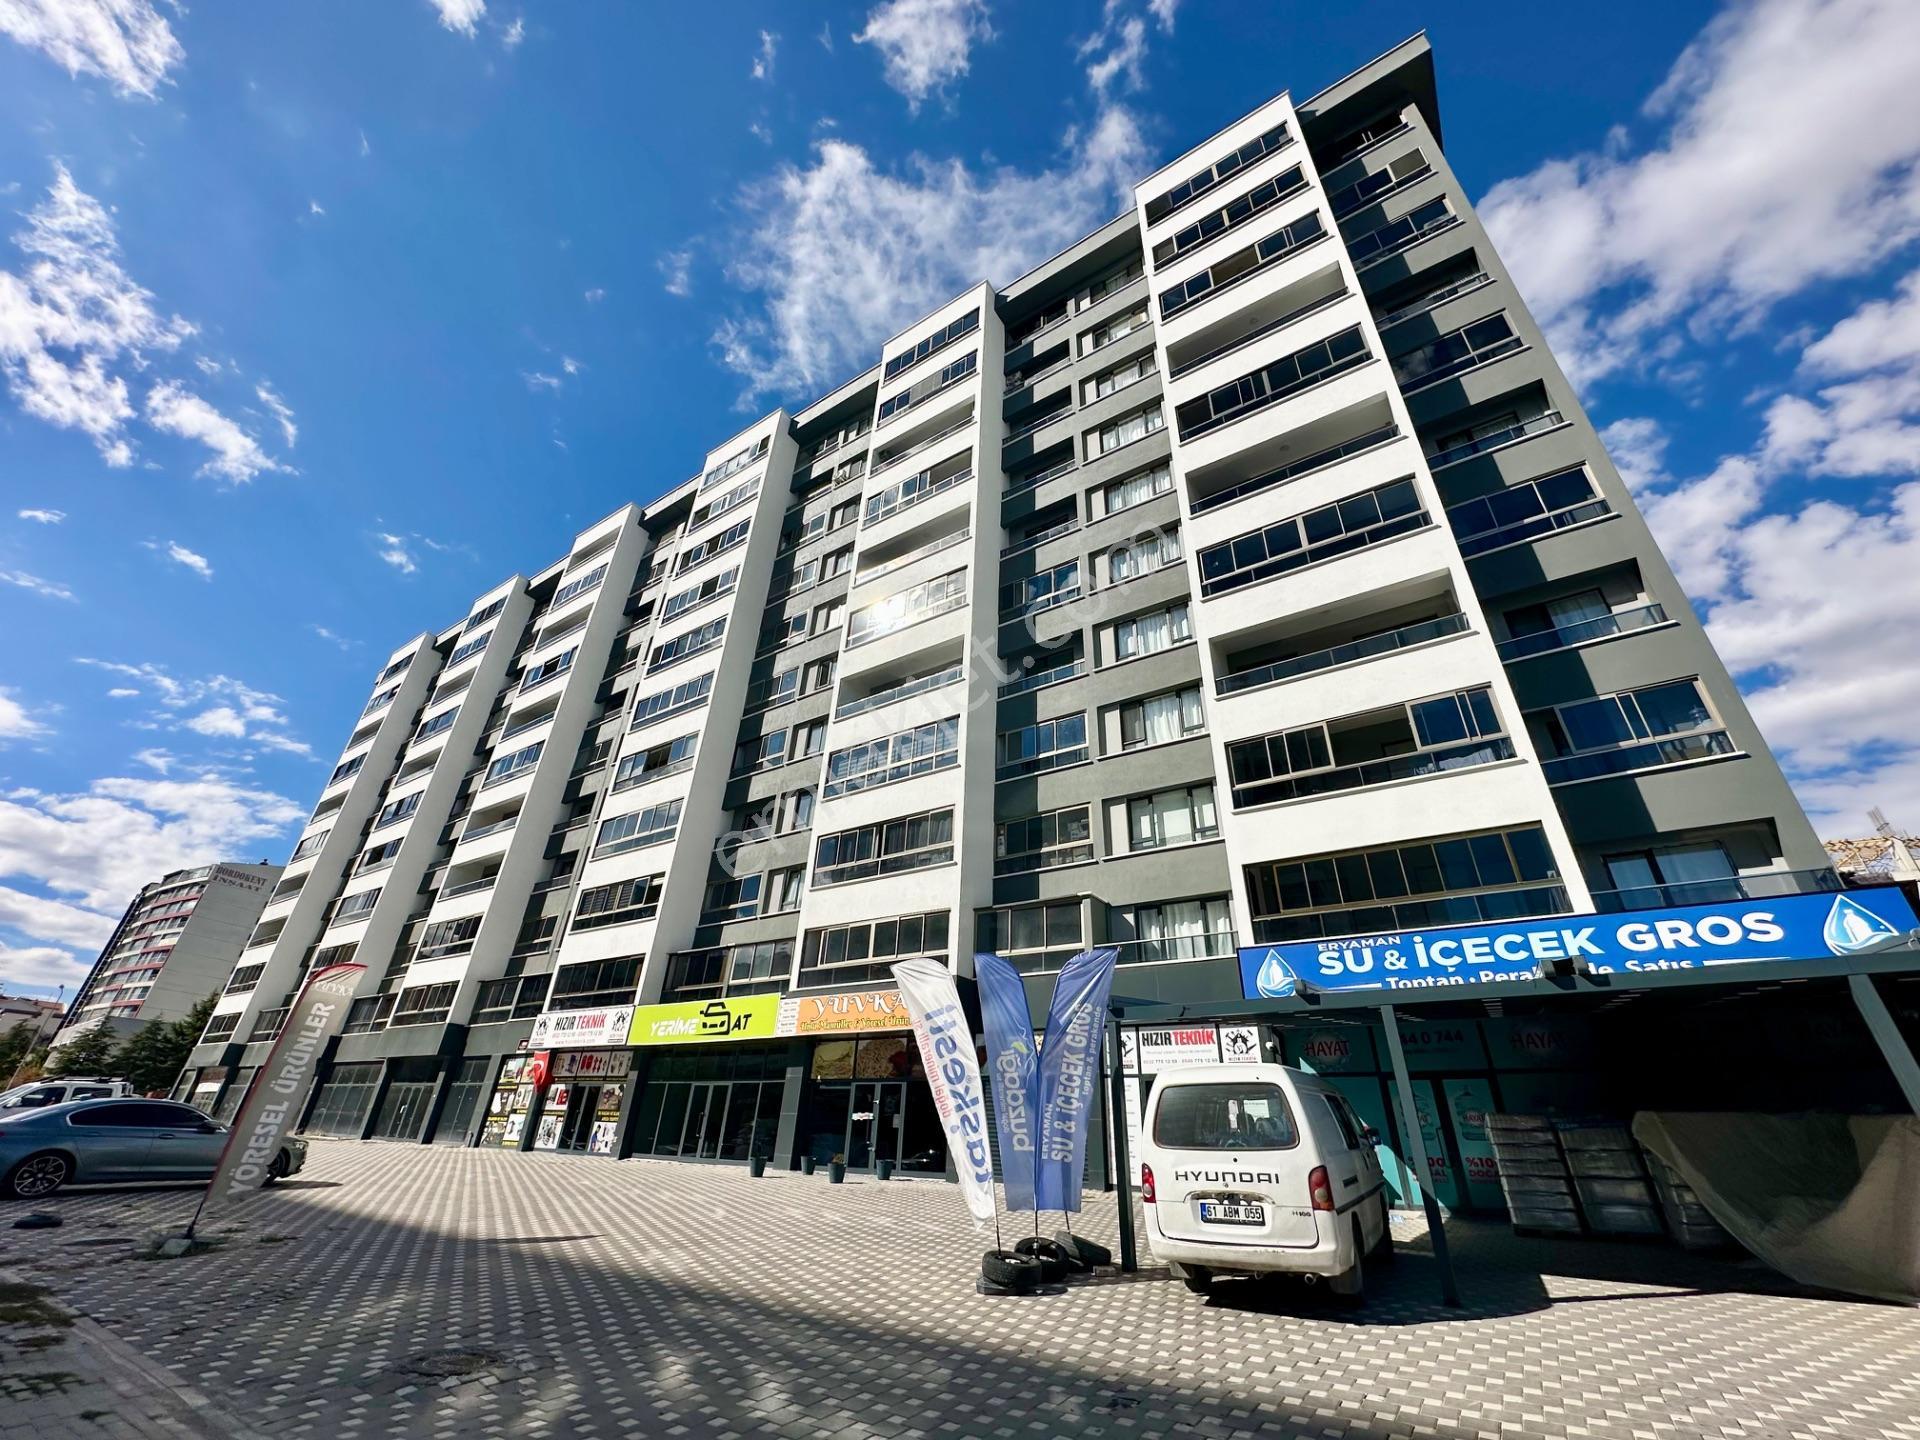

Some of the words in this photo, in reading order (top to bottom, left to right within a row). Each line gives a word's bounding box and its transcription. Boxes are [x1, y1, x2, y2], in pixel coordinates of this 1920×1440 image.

[1318, 936, 1401, 951] ERYAMAN
[1319, 948, 1374, 975] SU
[1384, 950, 1408, 970] &
[1413, 927, 1605, 972] İÇECEK
[1616, 912, 1784, 951] GROS
[554, 1016, 576, 1031] HIZIR
[576, 1011, 608, 1029] TEKNİK
[650, 1017, 700, 1036] YERİME
[1142, 1032, 1172, 1046] HIZIR
[1173, 1028, 1216, 1045] TEKNİK
[1303, 1041, 1350, 1056] HAYAT
[227, 1099, 290, 1199] YÖRESEL
[278, 1001, 336, 1095] ÜRÜNLER
[1042, 1103, 1053, 1160] ERYAMAN
[1054, 1122, 1076, 1133] &
[1051, 1136, 1073, 1163] SU
[1175, 1171, 1280, 1184] HYUNDAI
[1206, 1206, 1217, 1217] 61
[1223, 1207, 1240, 1218] ABM
[1244, 1207, 1262, 1219] 055
